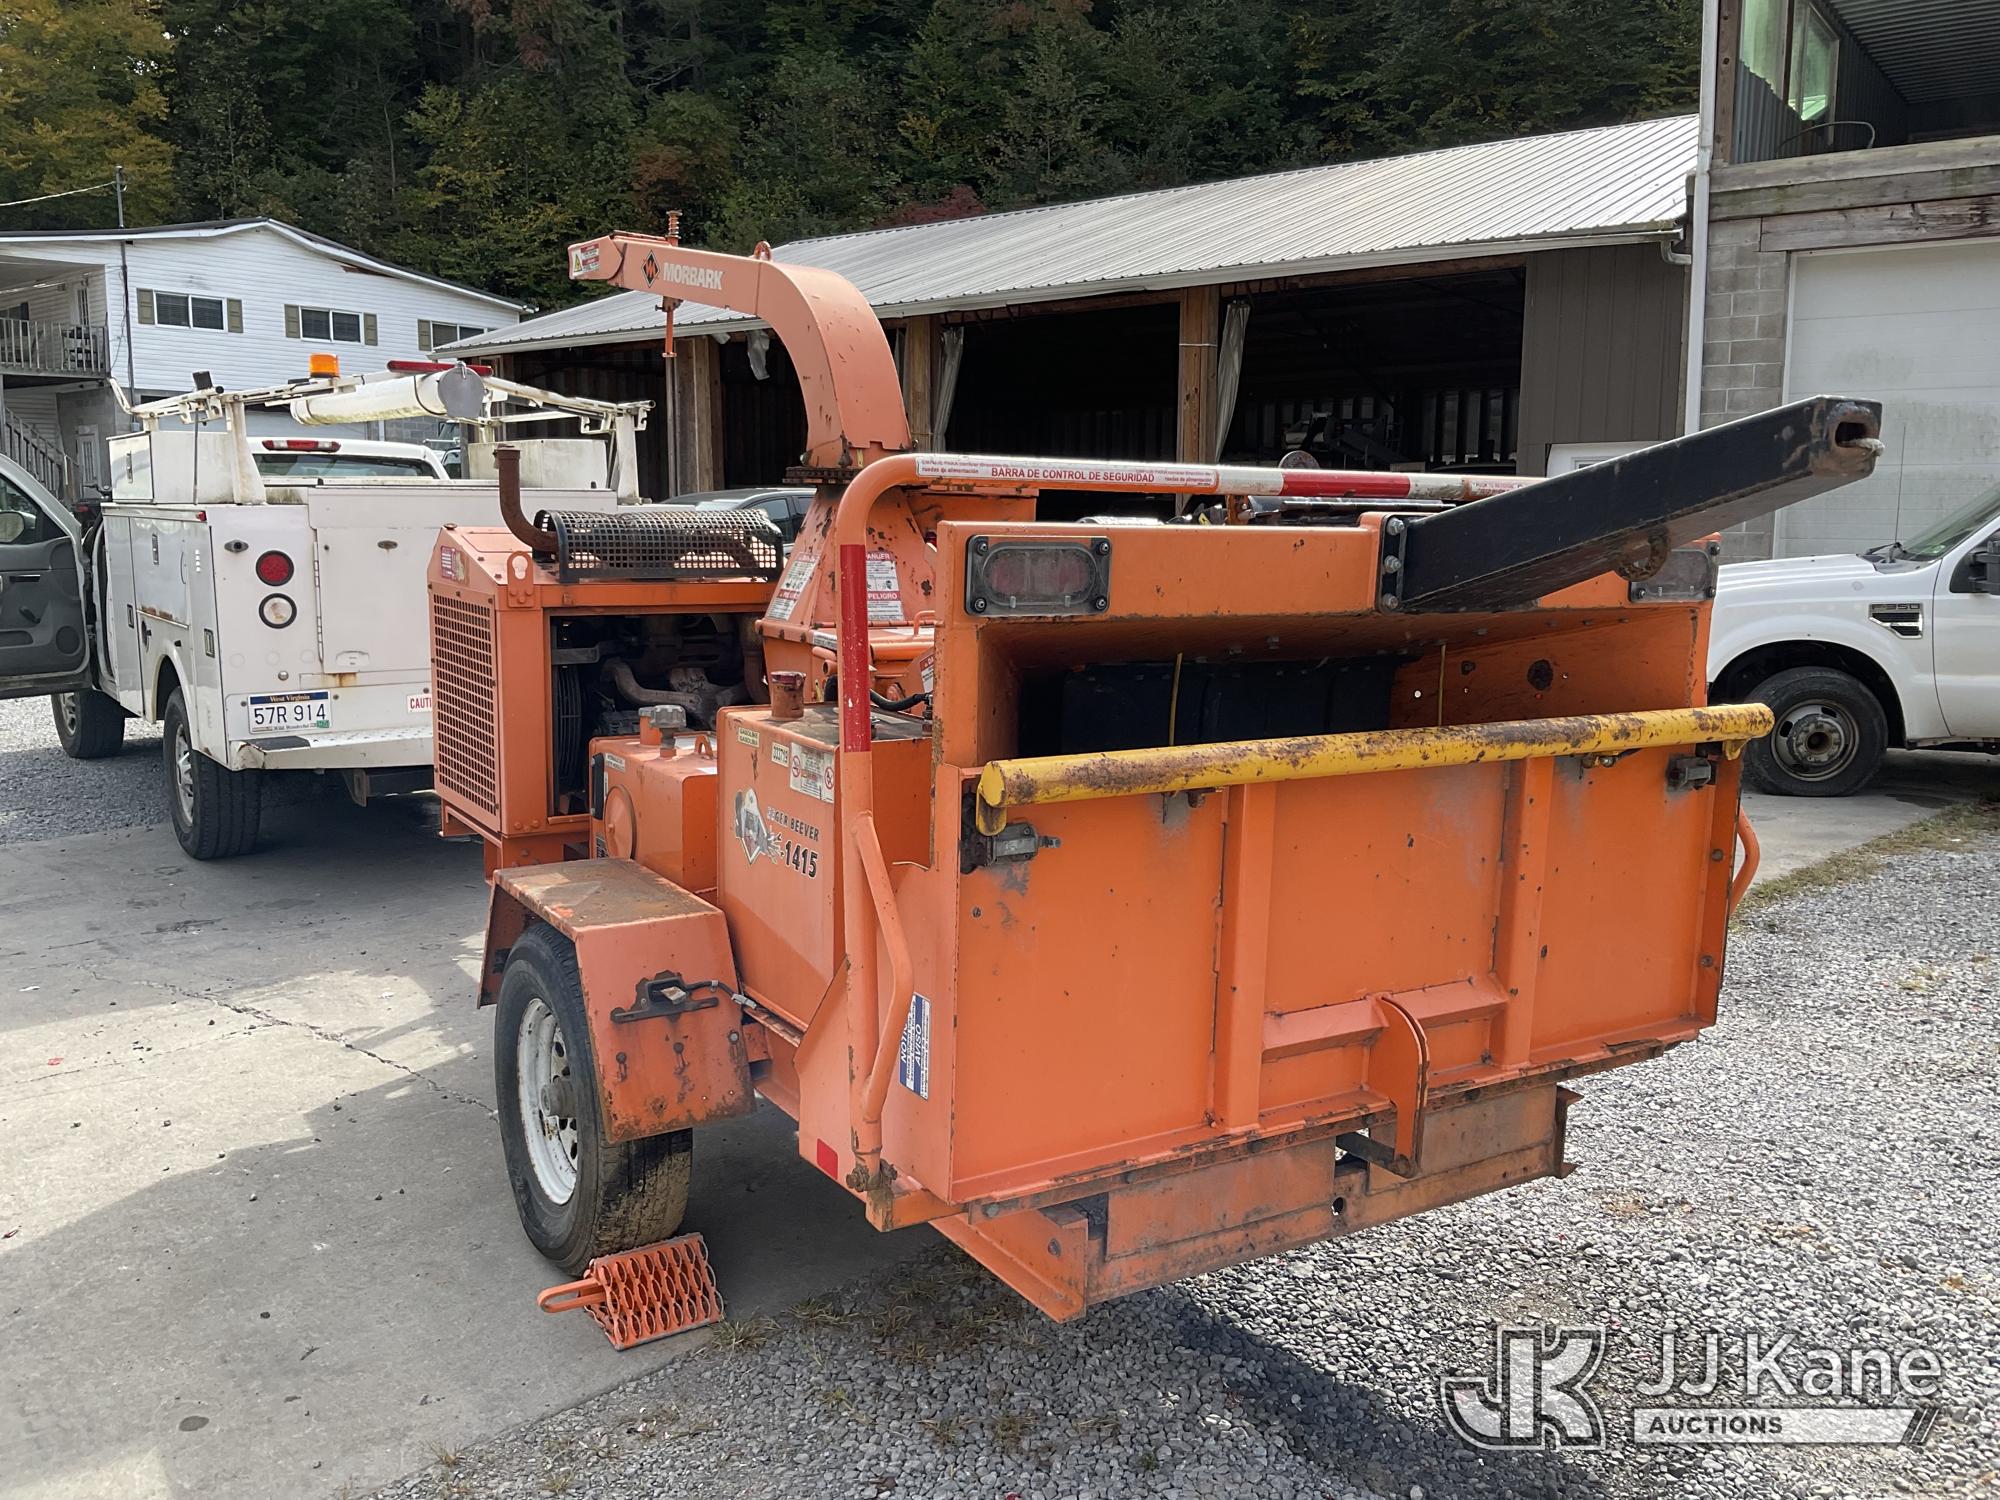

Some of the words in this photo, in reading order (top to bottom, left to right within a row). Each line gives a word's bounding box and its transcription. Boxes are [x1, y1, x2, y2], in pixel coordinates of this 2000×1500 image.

[663, 262, 724, 290] MORBARK
[991, 467, 1025, 478] BARRA
[1027, 468, 1040, 479] DE
[1042, 469, 1086, 480] CONTROL
[1088, 471, 1101, 481] DE
[1103, 472, 1155, 483] SEGURIDAD
[868, 592, 898, 600] PELIGRO
[270, 695, 286, 703] West
[287, 694, 310, 702] Virginia
[254, 706, 288, 725] 57R
[293, 703, 326, 722] 914
[790, 818, 820, 842] BEEVER
[785, 840, 819, 878] 1415
[914, 1023, 922, 1066] AVISO
